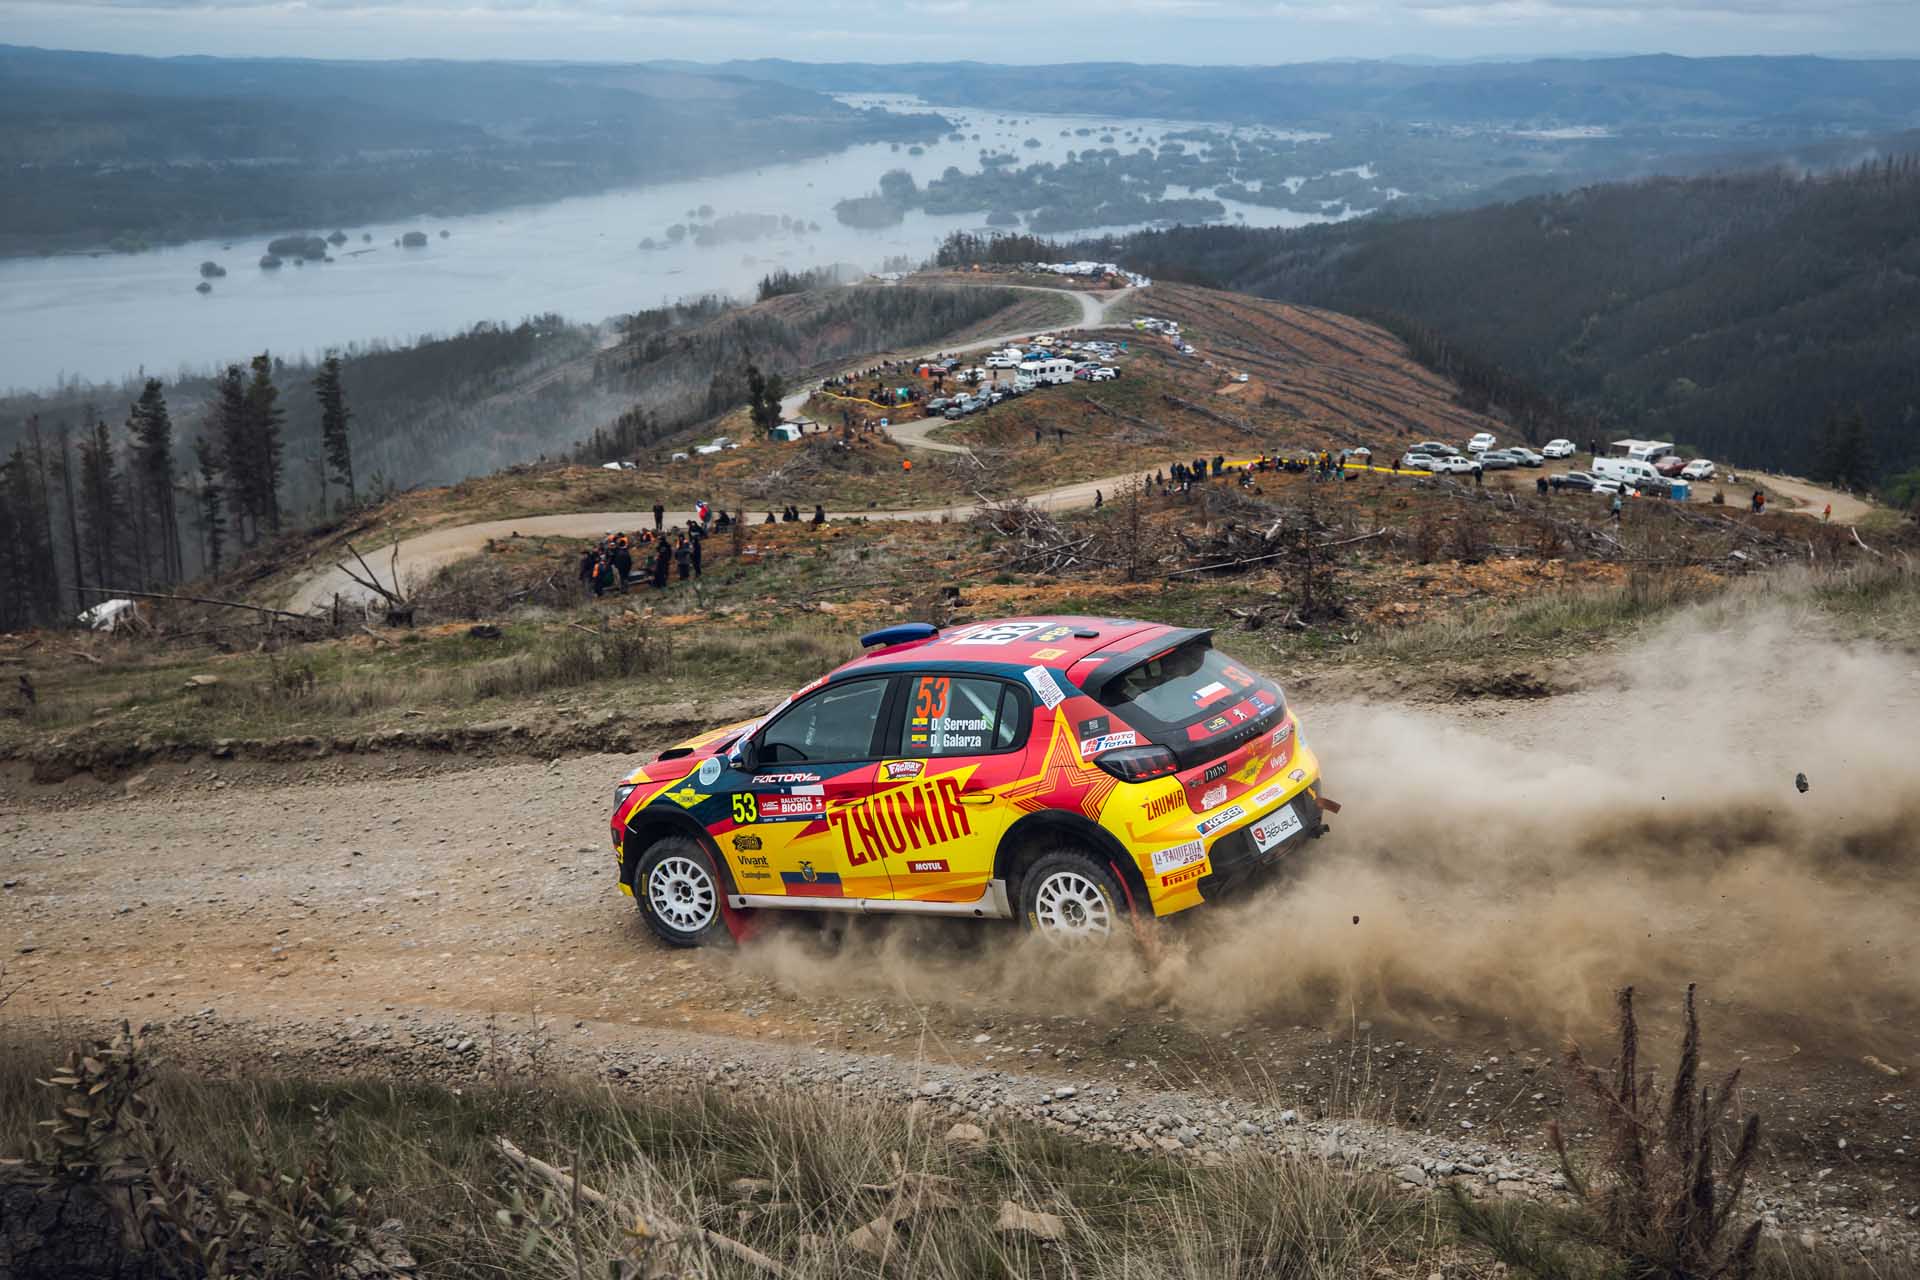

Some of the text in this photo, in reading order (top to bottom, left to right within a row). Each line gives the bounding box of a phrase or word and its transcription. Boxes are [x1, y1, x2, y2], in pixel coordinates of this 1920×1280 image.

[916, 676, 950, 719] 53
[930, 718, 987, 731] D. Serrano
[930, 734, 982, 747] D. Galarza
[1105, 733, 1134, 742] AUTO
[1104, 740, 1134, 749] TOTAL
[752, 773, 812, 783] FACTORY
[732, 792, 757, 823] 53
[1265, 815, 1298, 840] REPUBLIC
[1163, 840, 1202, 864] TAQUERIA
[915, 863, 942, 871] MOTUL
[1161, 863, 1207, 887] PIRELLI
